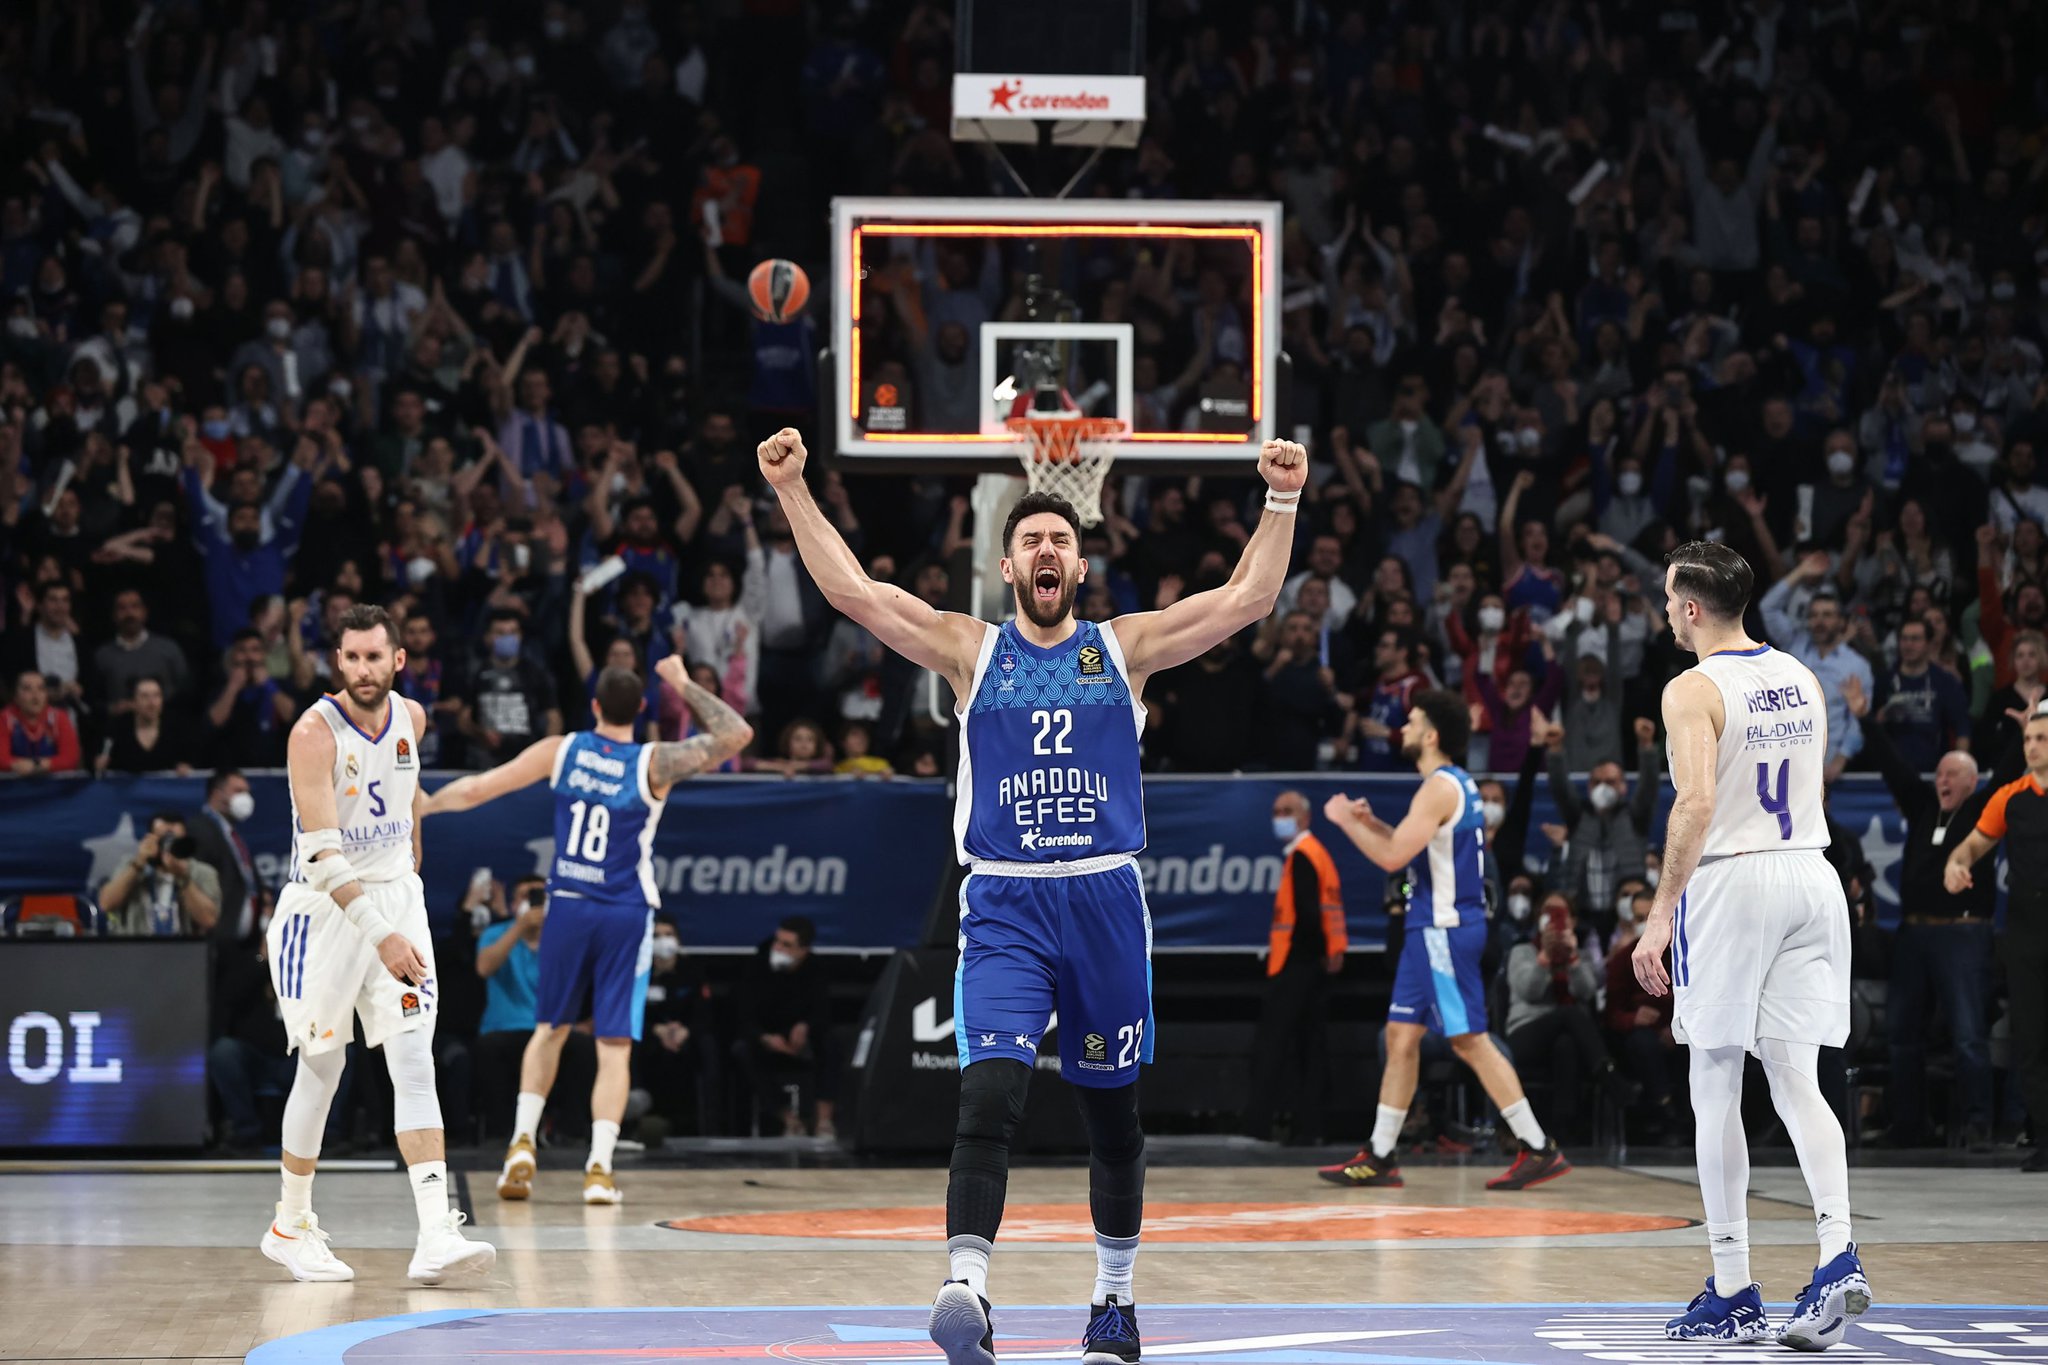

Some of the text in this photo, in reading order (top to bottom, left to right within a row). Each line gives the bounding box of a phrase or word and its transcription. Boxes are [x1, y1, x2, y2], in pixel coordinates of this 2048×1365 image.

[1019, 91, 1110, 111] corendon
[1031, 709, 1073, 756] 22
[368, 780, 387, 817] 5
[999, 767, 1108, 807] ANADOLU
[1757, 759, 1793, 840] 4
[565, 799, 611, 863] 18
[1015, 797, 1097, 826] EFES
[1037, 833, 1093, 848] corendon
[652, 845, 848, 895] orendon
[1140, 844, 1285, 894] endon
[1117, 1017, 1143, 1069] 22
